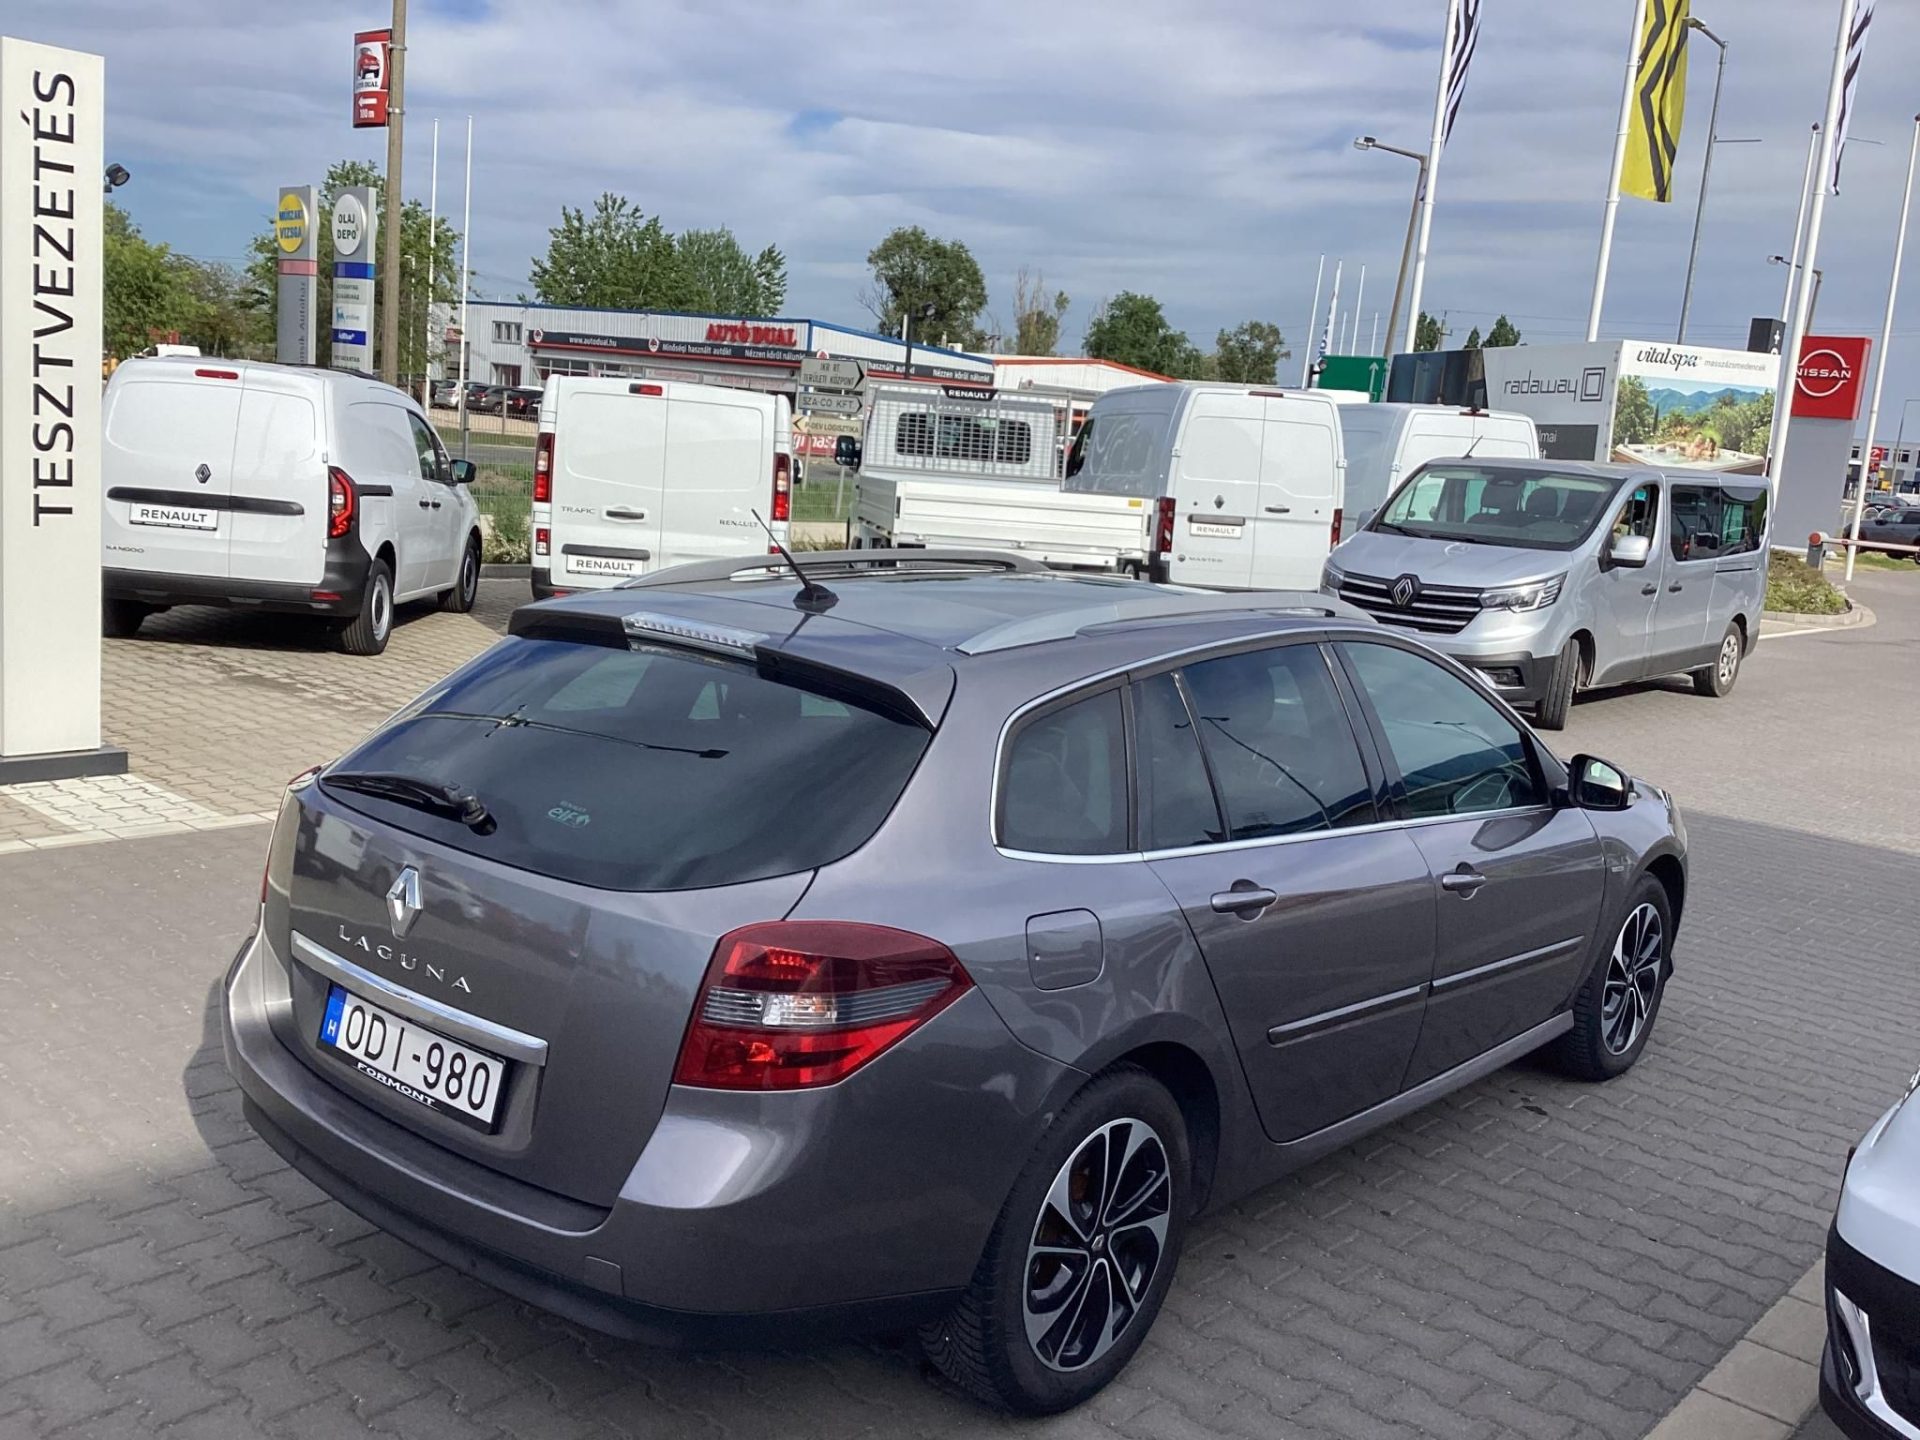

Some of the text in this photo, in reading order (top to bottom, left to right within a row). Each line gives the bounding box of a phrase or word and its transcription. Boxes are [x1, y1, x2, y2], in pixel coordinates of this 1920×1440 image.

[338, 213, 355, 224] OLAJ
[20, 69, 76, 528] TESZTVEZETÉS
[705, 320, 797, 348] AUTÓ DUAL
[569, 336, 617, 348] www.autodual.hu
[687, 345, 712, 355] használt
[744, 349, 766, 360] Nézzen
[1795, 367, 1852, 379] NISSAN
[1503, 369, 1578, 403] radaway
[948, 389, 990, 400] RENAULT
[824, 423, 859, 433] LOGISZTIKA
[140, 508, 208, 523] RENAULT
[561, 506, 596, 515] TRAFIC
[719, 519, 759, 529] RENAULT
[1196, 525, 1236, 535] RENAULT
[576, 559, 635, 572] RENAULT
[337, 924, 473, 994] LAGUNA
[326, 1005, 491, 1111] H ODI-980
[356, 1062, 436, 1107] FORMONT
